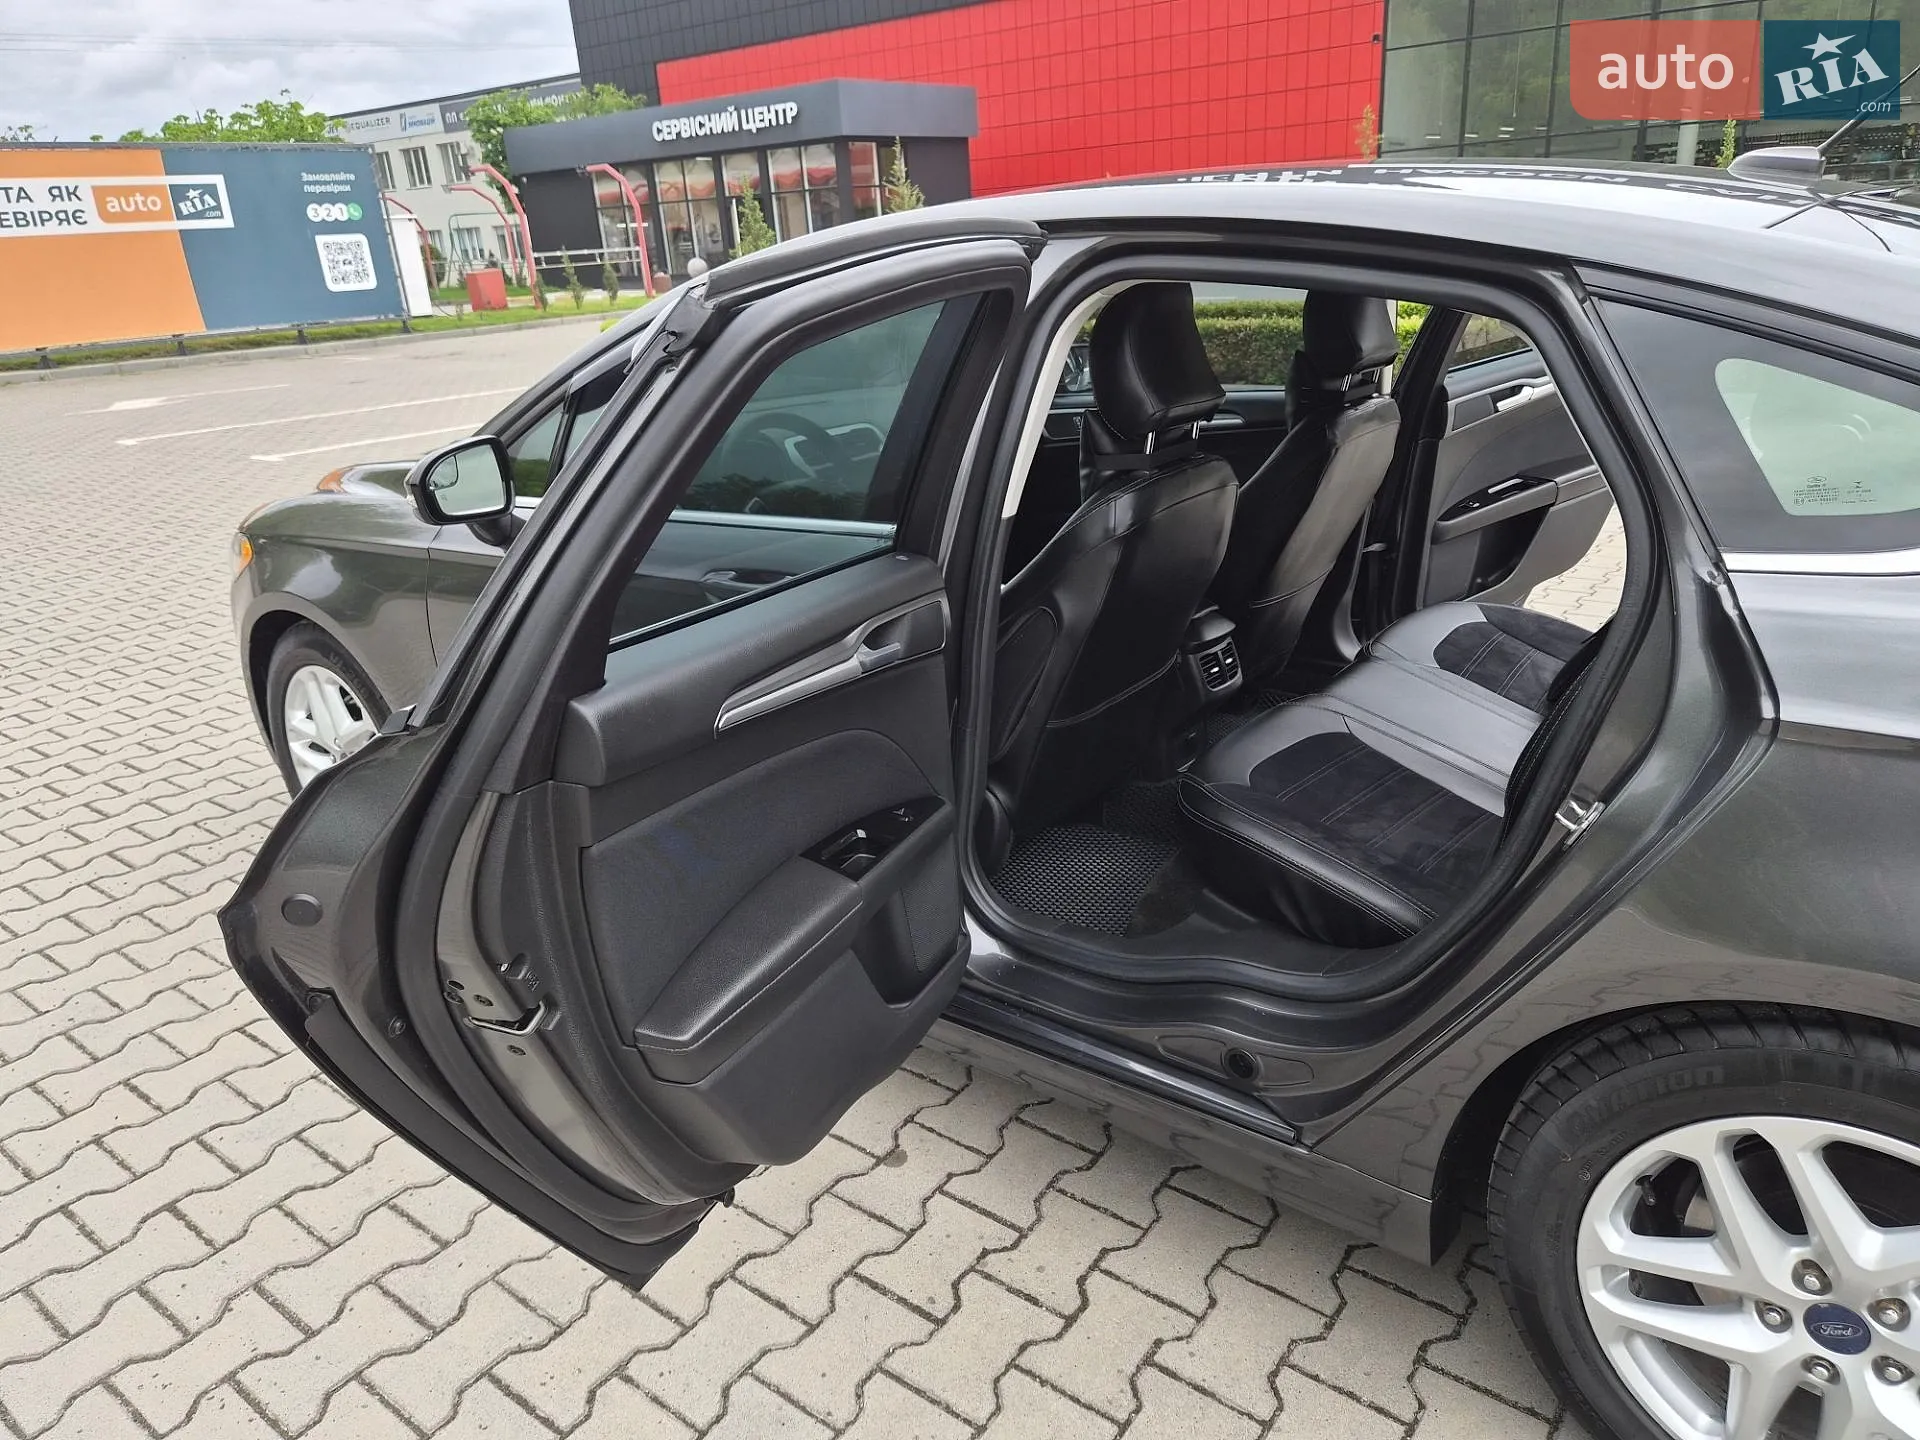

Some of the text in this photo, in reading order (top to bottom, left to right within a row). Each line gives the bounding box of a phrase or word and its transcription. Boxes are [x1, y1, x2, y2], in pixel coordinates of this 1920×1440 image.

[652, 101, 798, 142] СЕРВІСНИЙ ЦЕНТР
[48, 185, 82, 202] ЯК
[304, 184, 351, 193] перевірки
[106, 193, 217, 216] auto RIA
[1820, 1324, 1853, 1336] Ford
